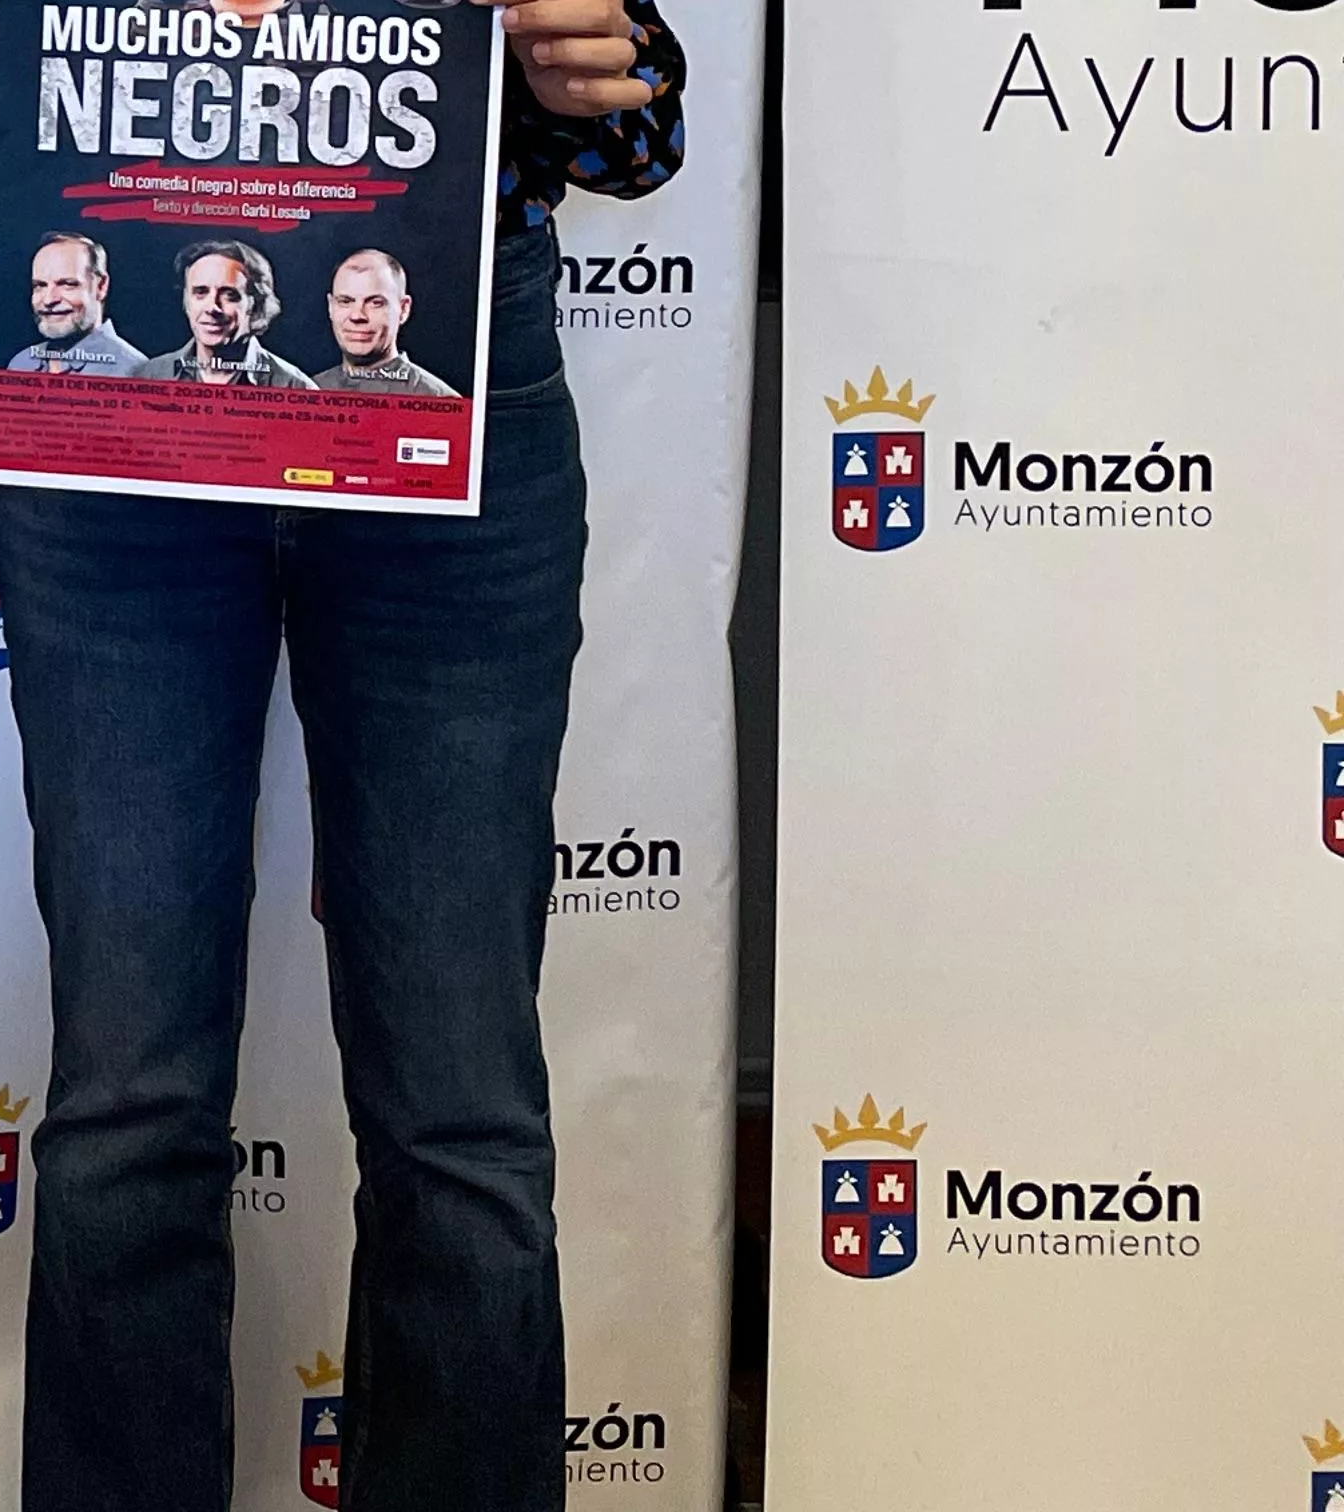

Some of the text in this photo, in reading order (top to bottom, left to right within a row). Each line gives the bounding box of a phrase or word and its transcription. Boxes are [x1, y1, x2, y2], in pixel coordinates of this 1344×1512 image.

[41, 3, 443, 67] MUCHOS AMIGOS
[37, 56, 439, 170] NEGROS
[109, 172, 133, 188] Una
[136, 176, 189, 192] comedia
[240, 182, 276, 197] sobre
[278, 184, 291, 196] la
[292, 183, 357, 199] diferencia
[955, 442, 1211, 492] Monzón
[955, 499, 1211, 531] Ayuntamiento
